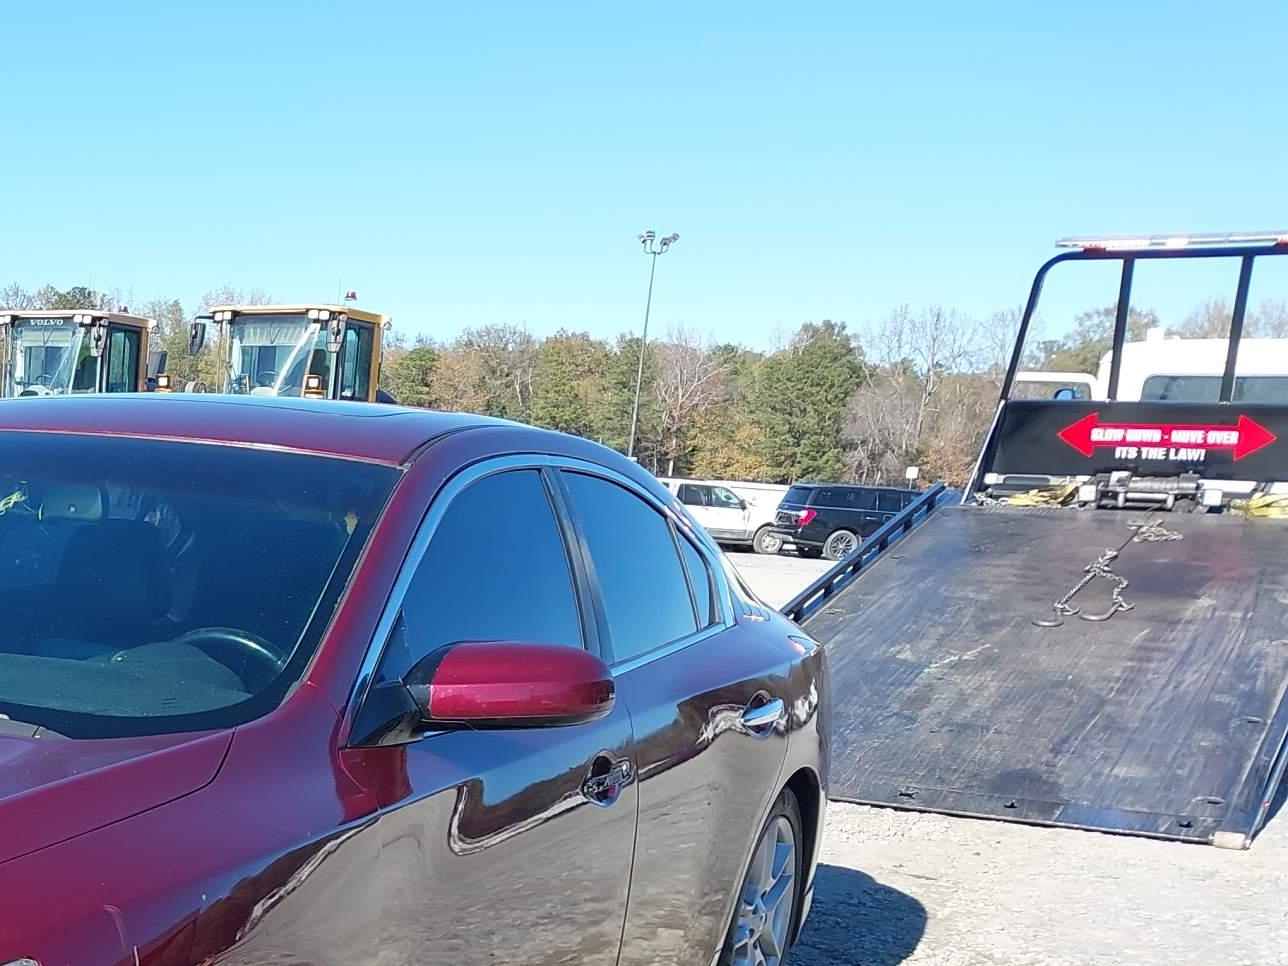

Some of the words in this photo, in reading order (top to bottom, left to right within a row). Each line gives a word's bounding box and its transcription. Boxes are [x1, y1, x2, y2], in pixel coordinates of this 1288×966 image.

[1171, 430, 1205, 443] MOVE
[1206, 431, 1239, 444] OVER
[1114, 447, 1138, 458] ITS
[1141, 448, 1167, 459] THE
[1169, 449, 1206, 461] LAW!
